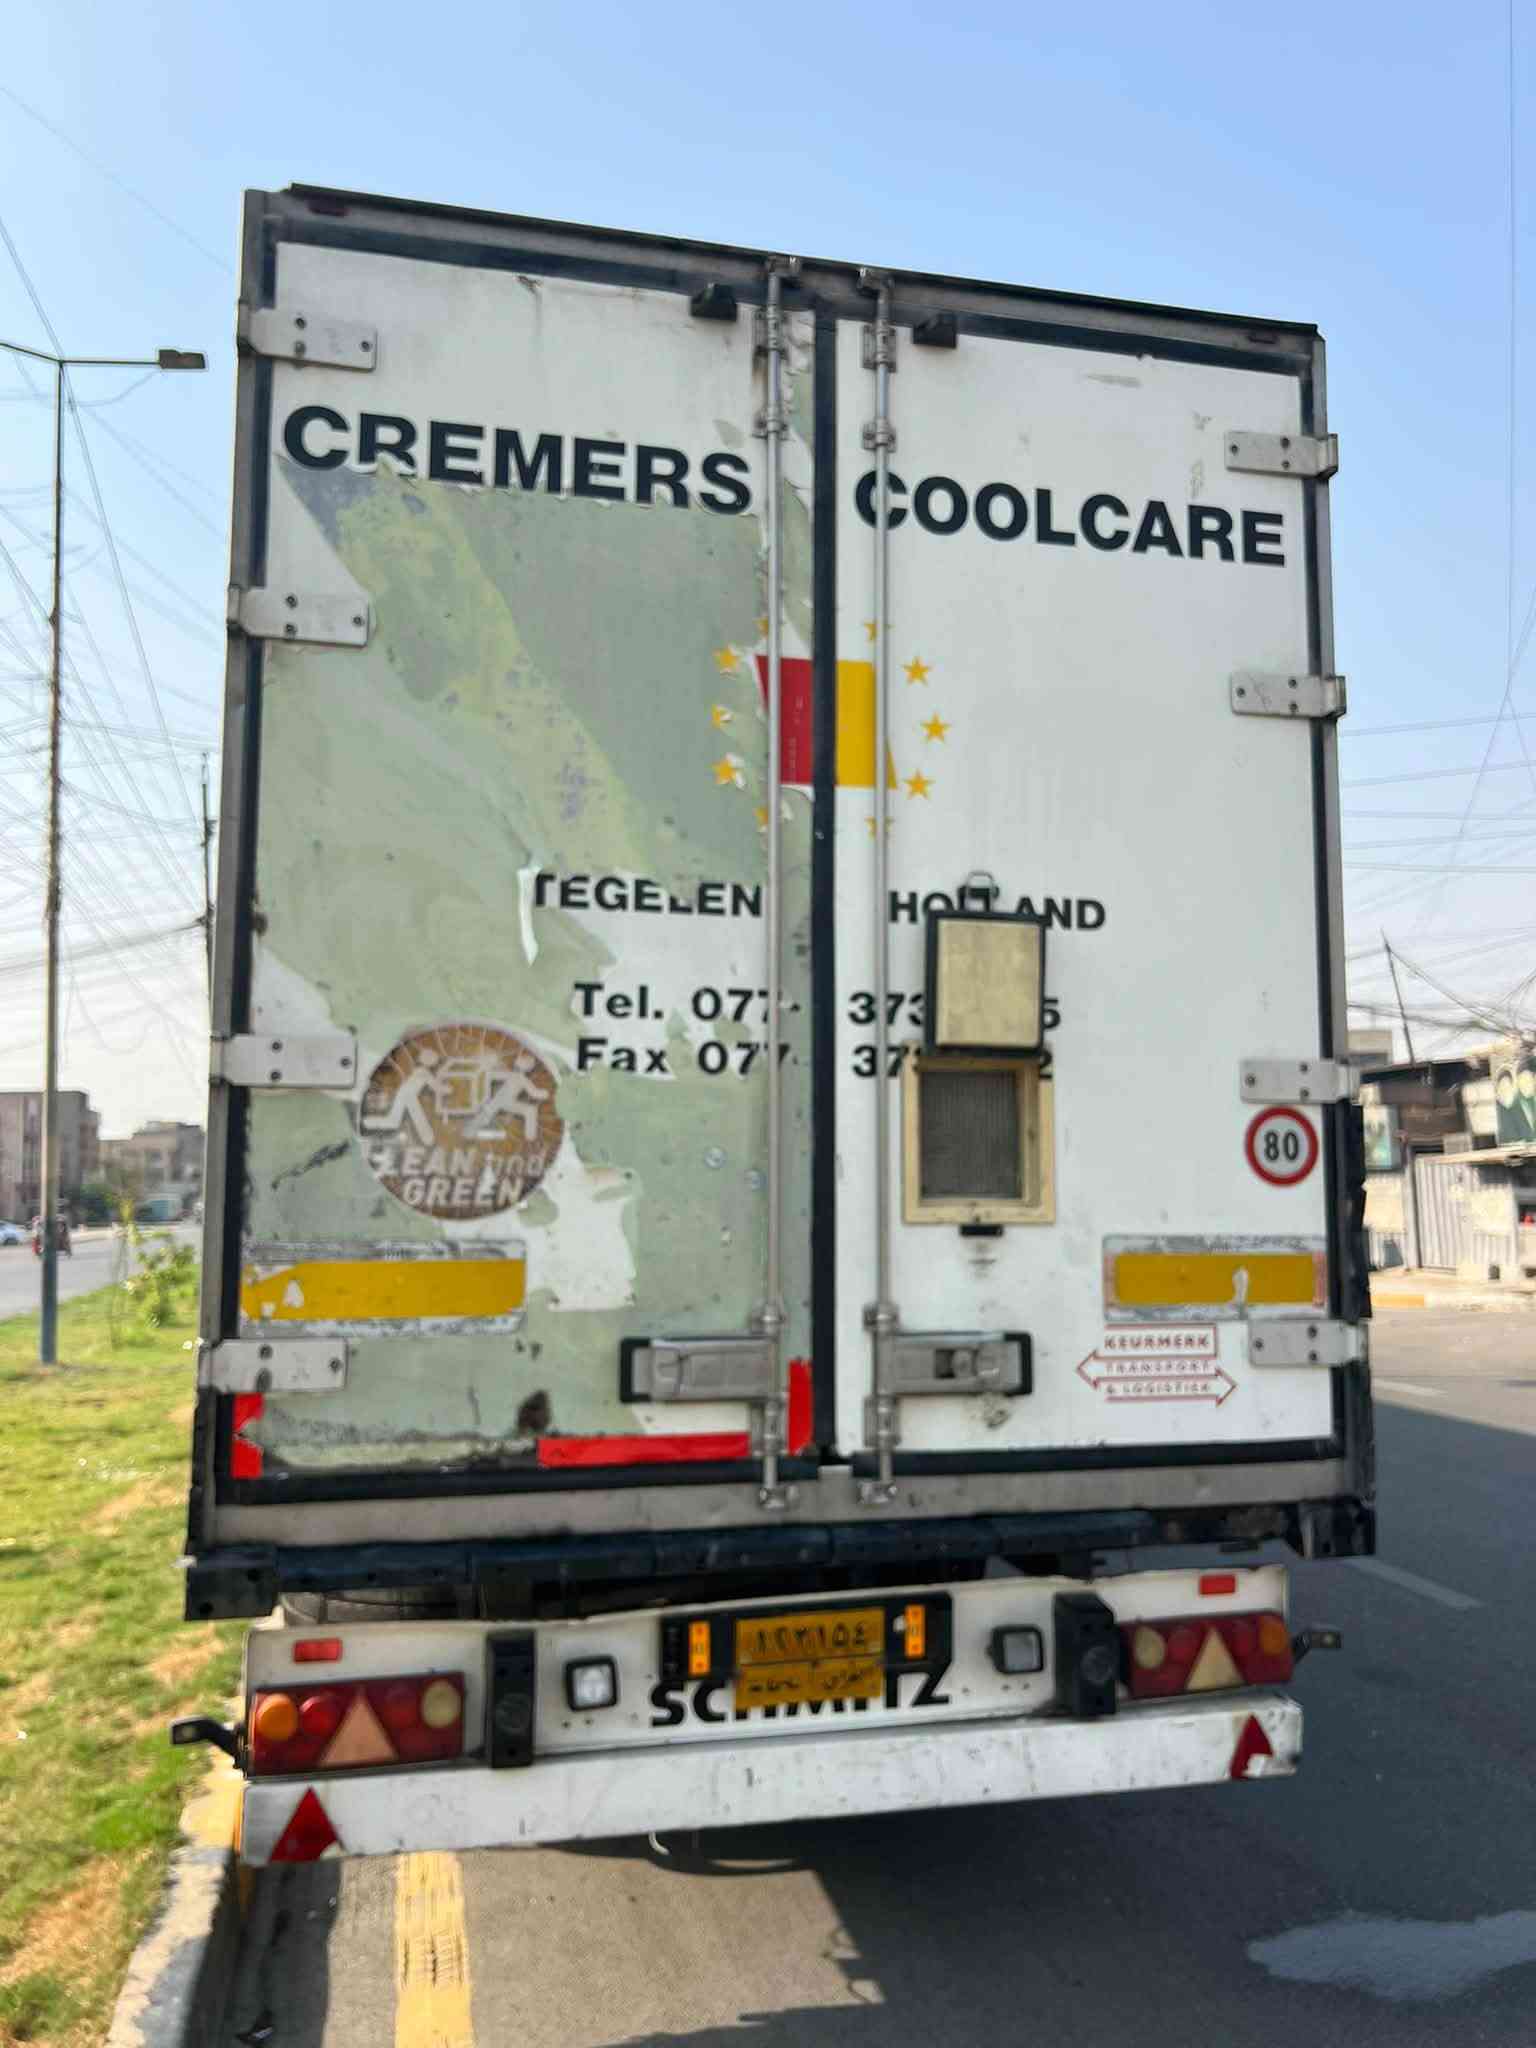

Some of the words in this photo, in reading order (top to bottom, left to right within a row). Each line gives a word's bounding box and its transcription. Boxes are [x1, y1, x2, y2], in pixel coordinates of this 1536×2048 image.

[284, 405, 752, 515] CREMERS
[855, 470, 1285, 567] COOLCARE
[574, 982, 664, 1020] Tel.
[577, 1038, 668, 1074] Fax
[1264, 1131, 1299, 1162] 80
[402, 1176, 523, 1208] GREEN
[1104, 1334, 1209, 1350] KEURMERK
